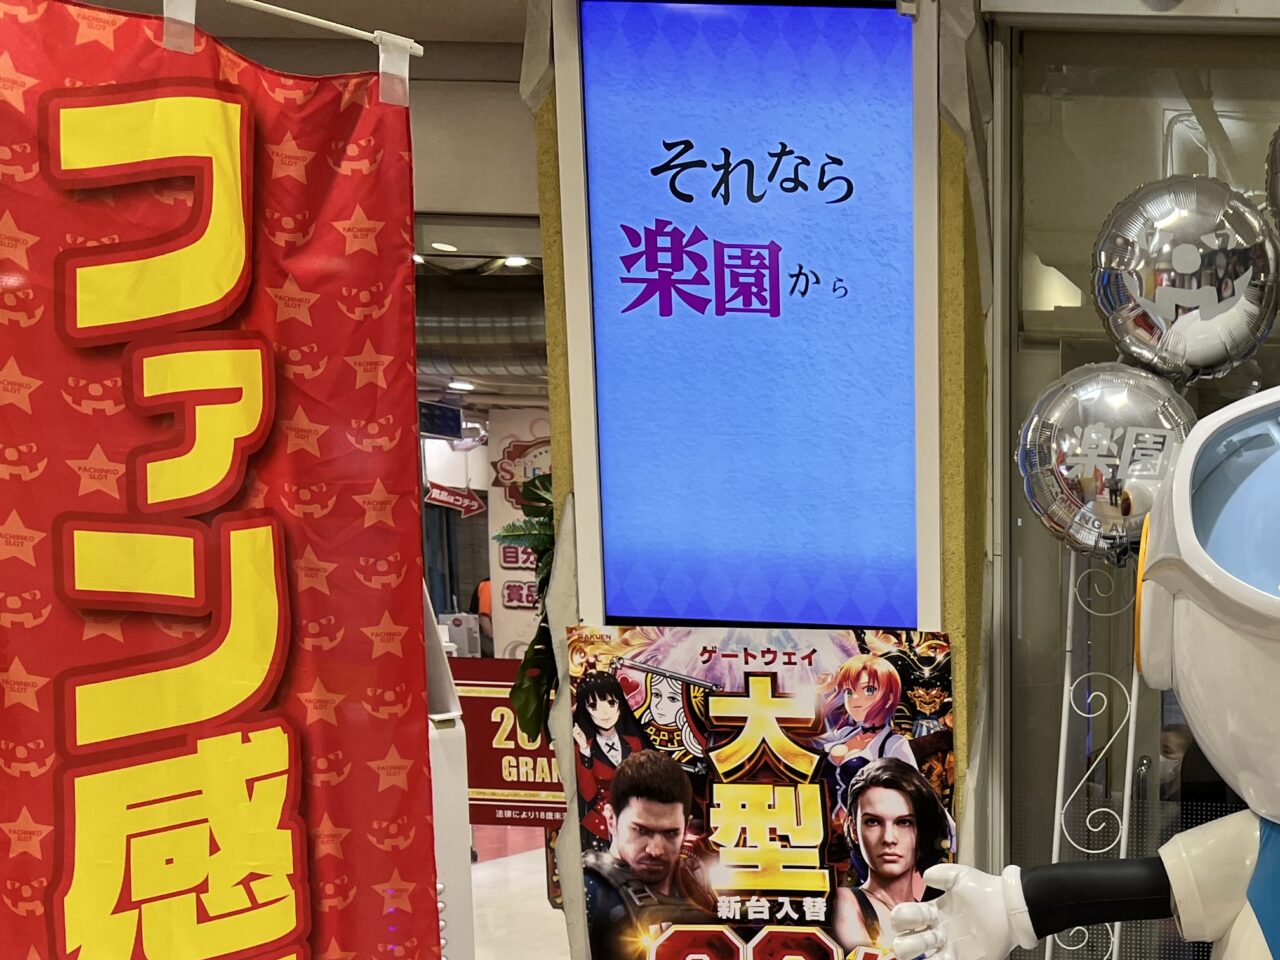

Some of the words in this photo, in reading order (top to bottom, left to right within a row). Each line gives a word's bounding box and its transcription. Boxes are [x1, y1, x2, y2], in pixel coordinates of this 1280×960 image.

[650, 139, 855, 206] それなら
[619, 217, 850, 318] 楽園から
[1065, 422, 1177, 481] 楽園
[699, 646, 818, 667] ゲートウェイ
[708, 676, 830, 895] 大型
[717, 896, 827, 923] 新台入替
